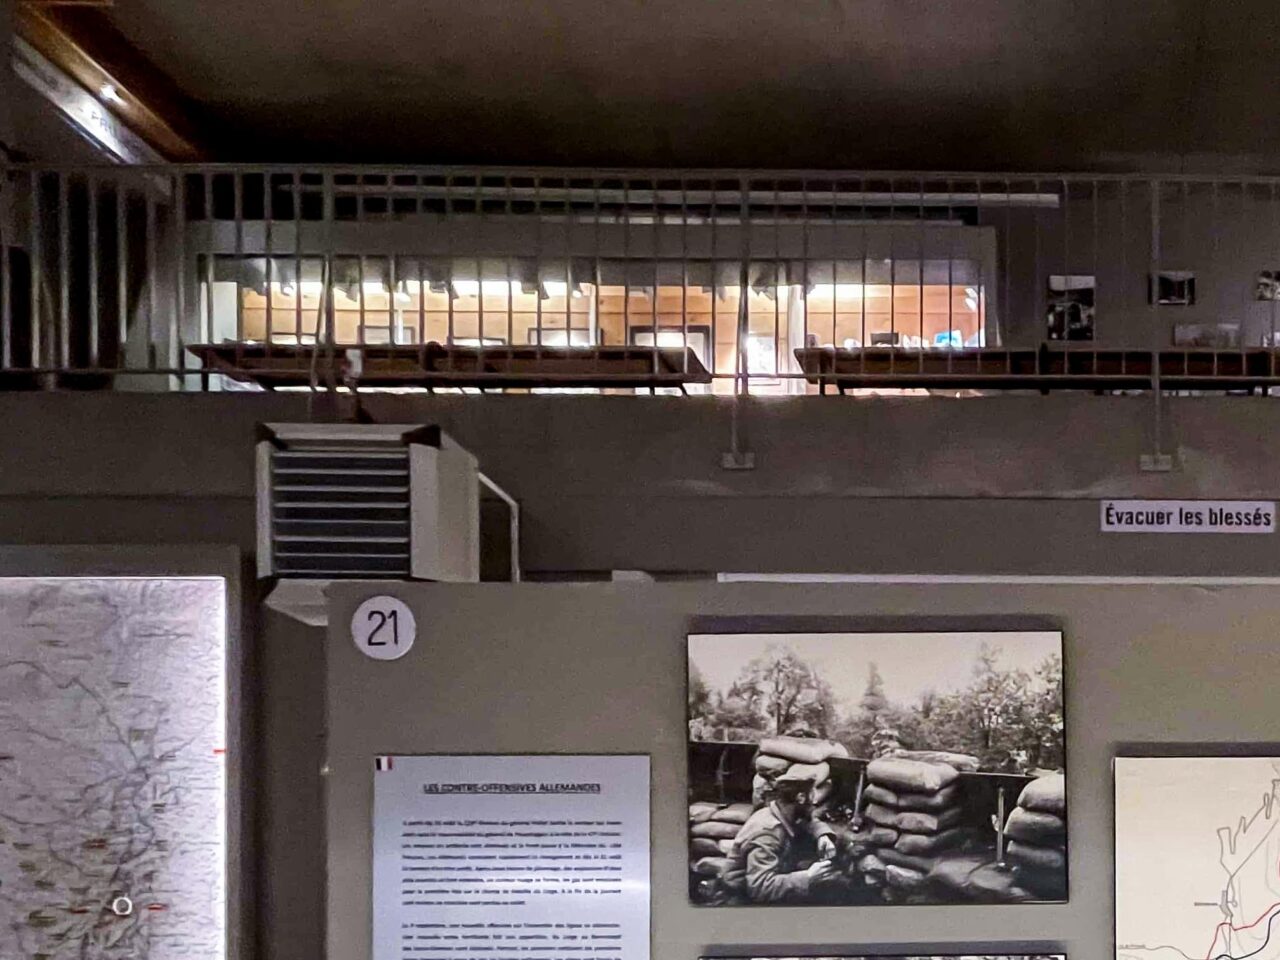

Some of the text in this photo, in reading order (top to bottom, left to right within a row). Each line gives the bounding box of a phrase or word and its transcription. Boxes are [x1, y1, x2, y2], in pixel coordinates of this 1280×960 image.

[1105, 503, 1272, 526] Évacuer les blessés
[367, 609, 399, 646] 21
[539, 783, 601, 793] ALLEMANDES
